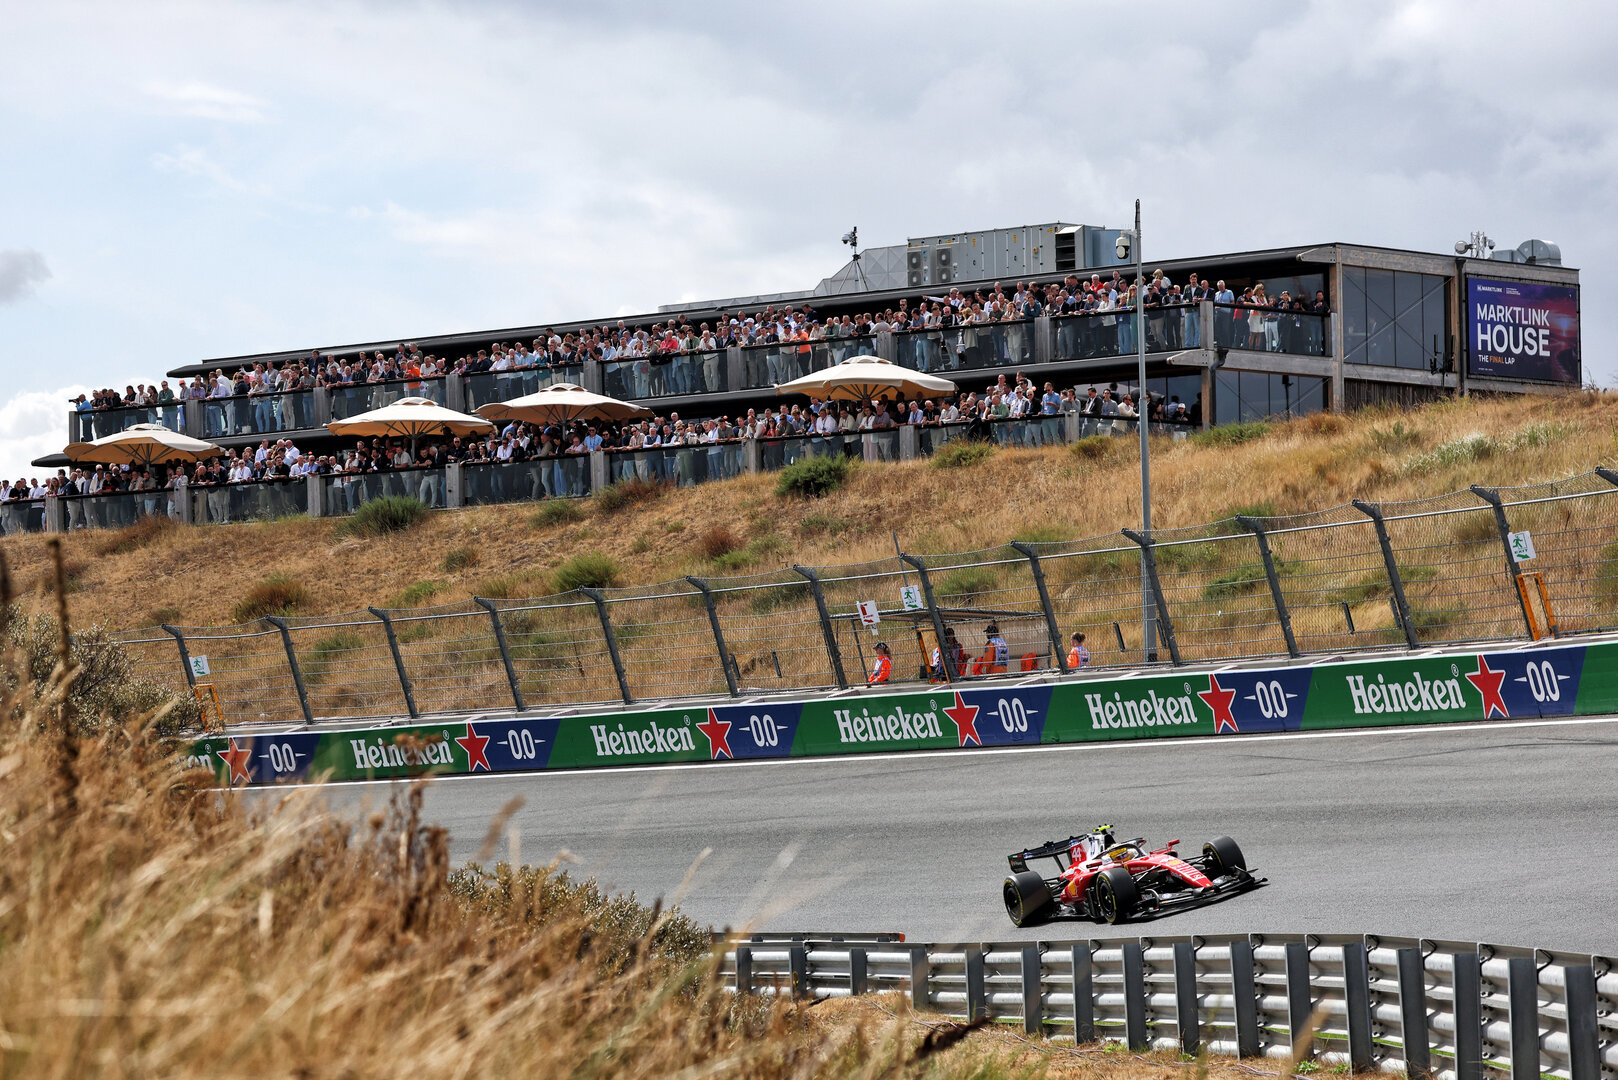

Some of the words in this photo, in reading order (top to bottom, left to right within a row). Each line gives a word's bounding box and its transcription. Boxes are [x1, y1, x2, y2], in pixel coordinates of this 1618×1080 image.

[1478, 303, 1550, 326] MARKTLINK
[1477, 323, 1550, 356] HOUSE
[1489, 356, 1504, 364] FINAL
[1346, 671, 1466, 714] Heineken
[1526, 660, 1560, 702] 0.0
[833, 706, 943, 743] Heineken
[998, 697, 1029, 733] 0.0
[1084, 689, 1198, 729] Heineken
[1255, 680, 1288, 719] 0.0
[507, 728, 536, 760] 0.0
[589, 721, 696, 756] Heineken
[749, 714, 779, 747] 0.0
[1071, 847, 1081, 861] 44
